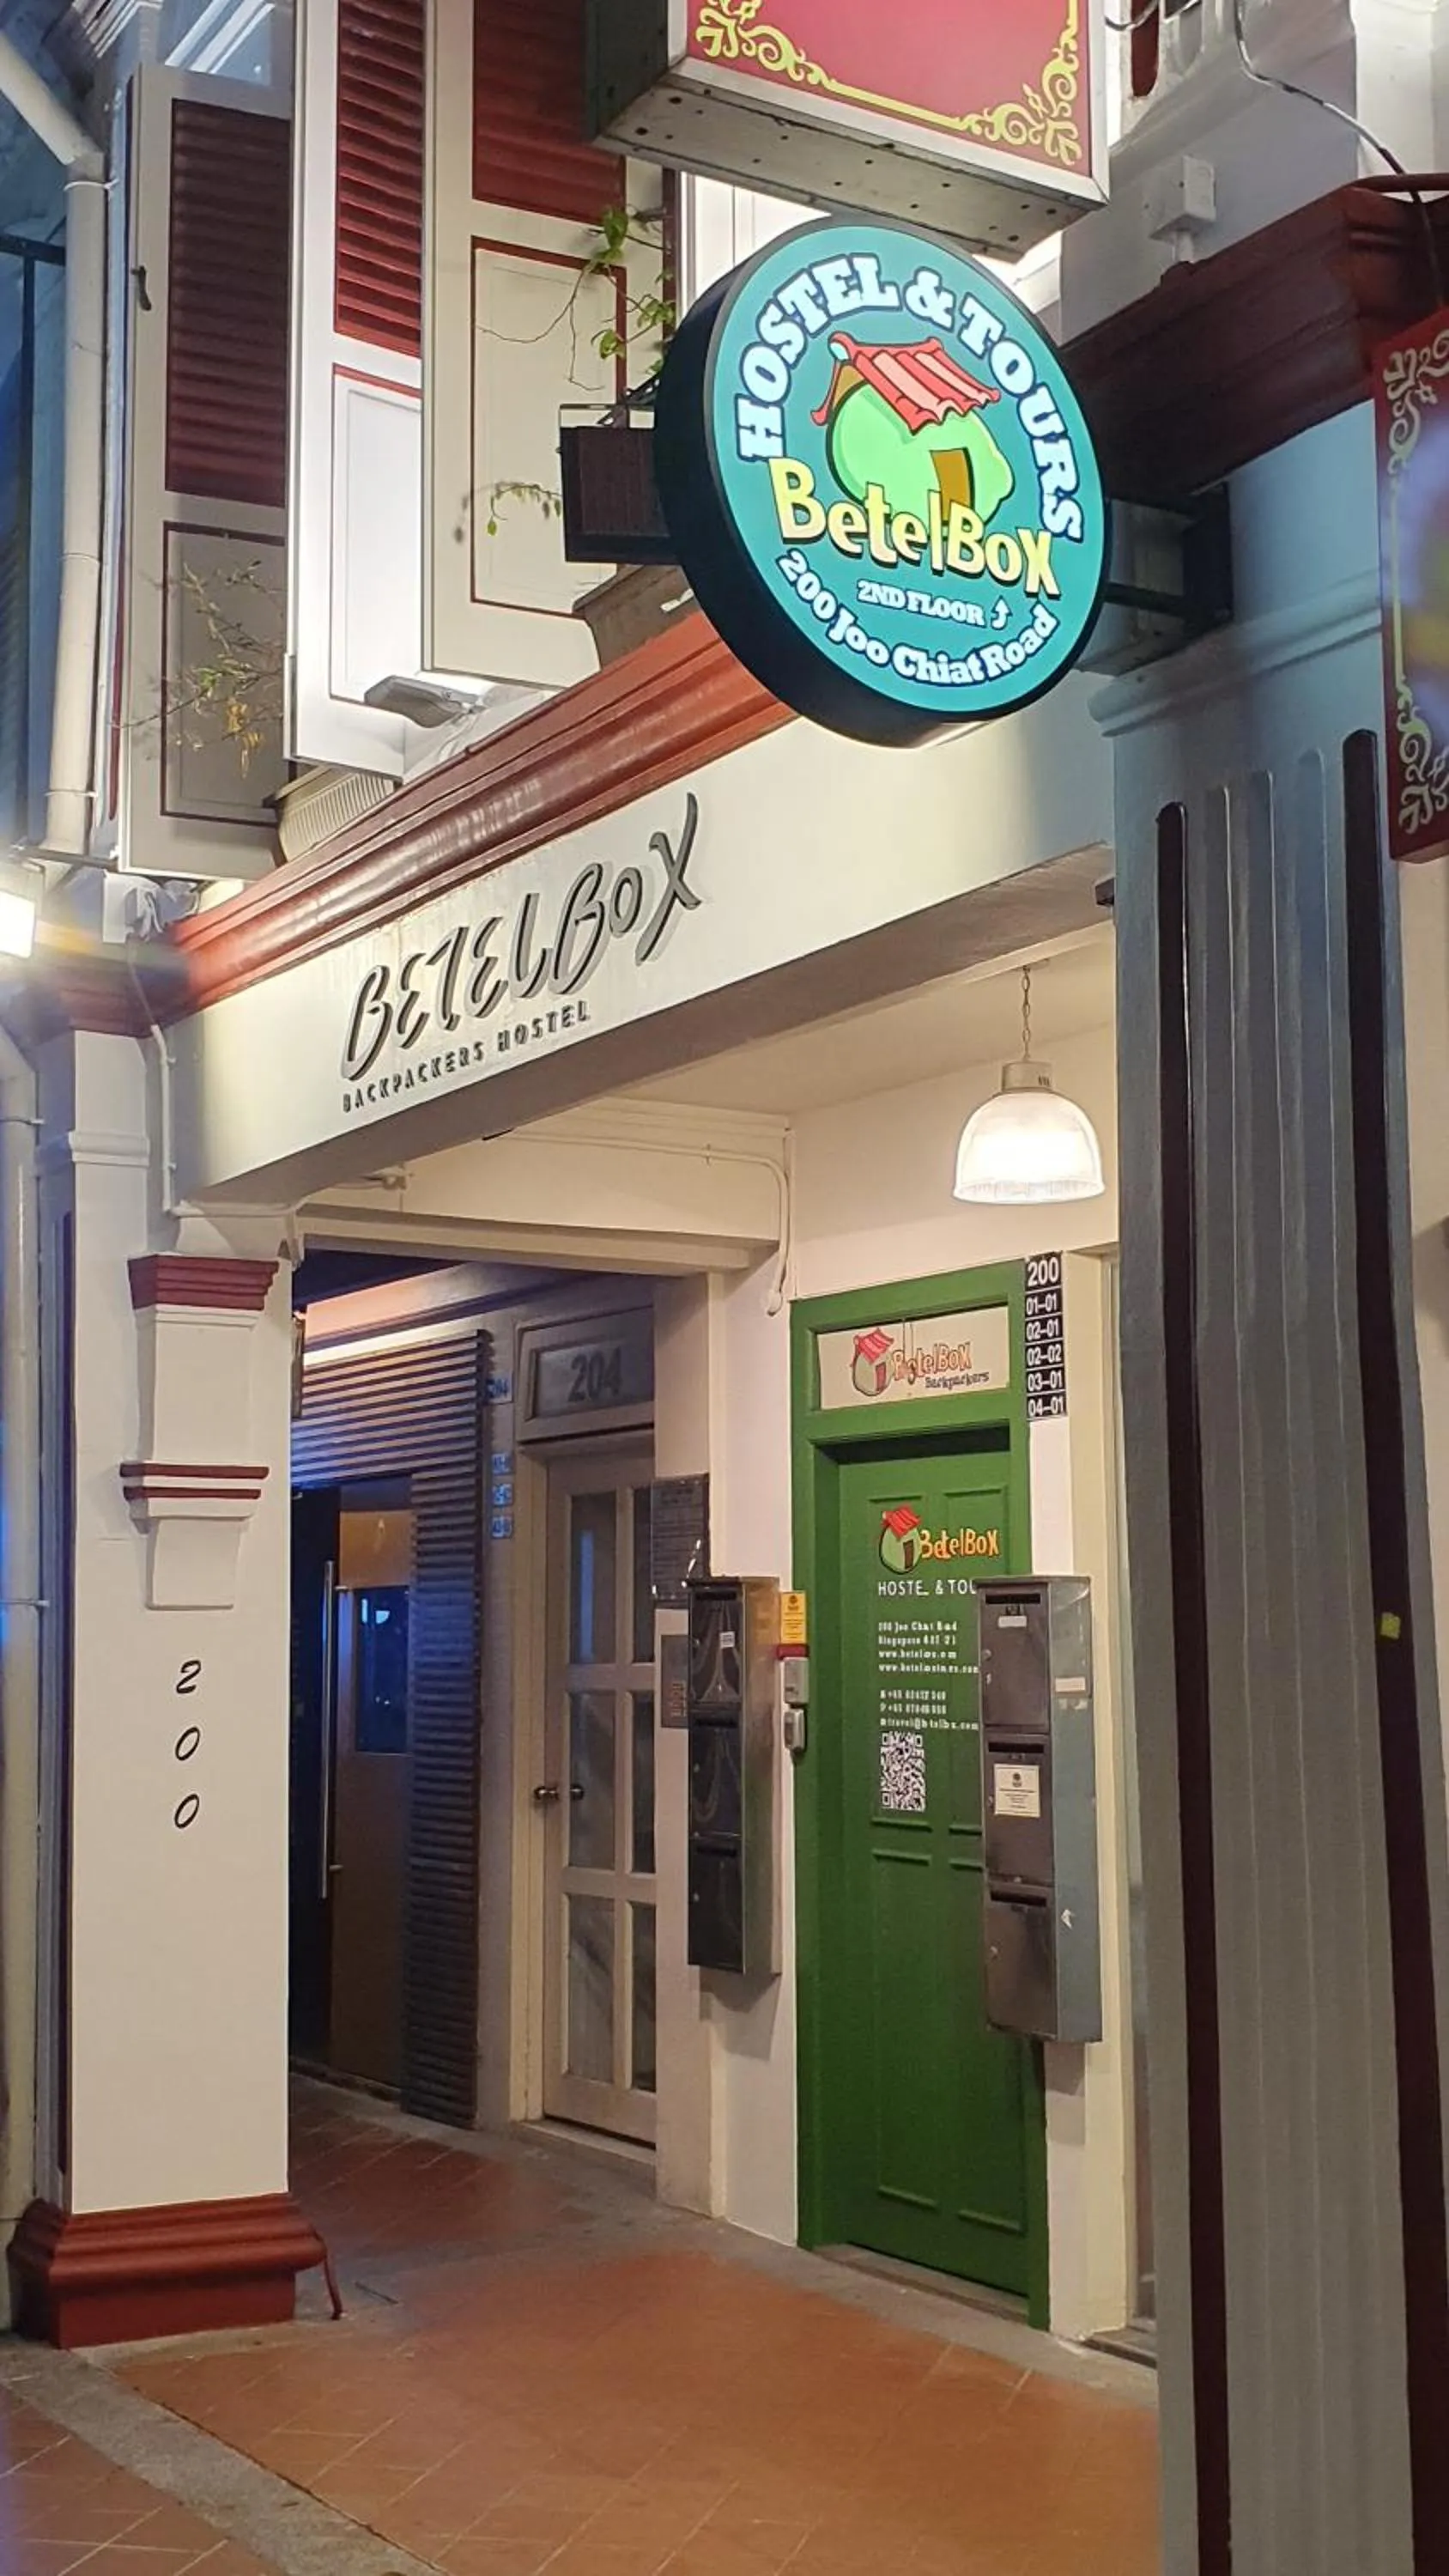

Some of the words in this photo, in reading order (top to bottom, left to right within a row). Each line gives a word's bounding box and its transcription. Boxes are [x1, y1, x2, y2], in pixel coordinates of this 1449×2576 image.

[735, 252, 902, 461] HOSTEL
[904, 267, 955, 330] &
[957, 294, 1084, 542] TOURS
[775, 550, 840, 622] 200
[826, 614, 890, 668] Joo
[892, 646, 984, 687] Chiat
[983, 605, 1060, 678] Road
[858, 580, 906, 612] 2ND
[907, 587, 985, 628] FLOOR
[343, 1041, 485, 1113] BACKPACKERS
[497, 1000, 591, 1052] HOSTEL
[1028, 1256, 1059, 1287] 200
[1026, 1293, 1058, 1315] 01-01
[1027, 1319, 1060, 1341] 02-01
[1027, 1344, 1062, 1367] 02-02
[567, 1346, 623, 1403] 204
[1028, 1370, 1063, 1392] 03-01
[1028, 1395, 1064, 1417] 04-01
[936, 1580, 943, 1595] &
[174, 1659, 202, 1830] 200
